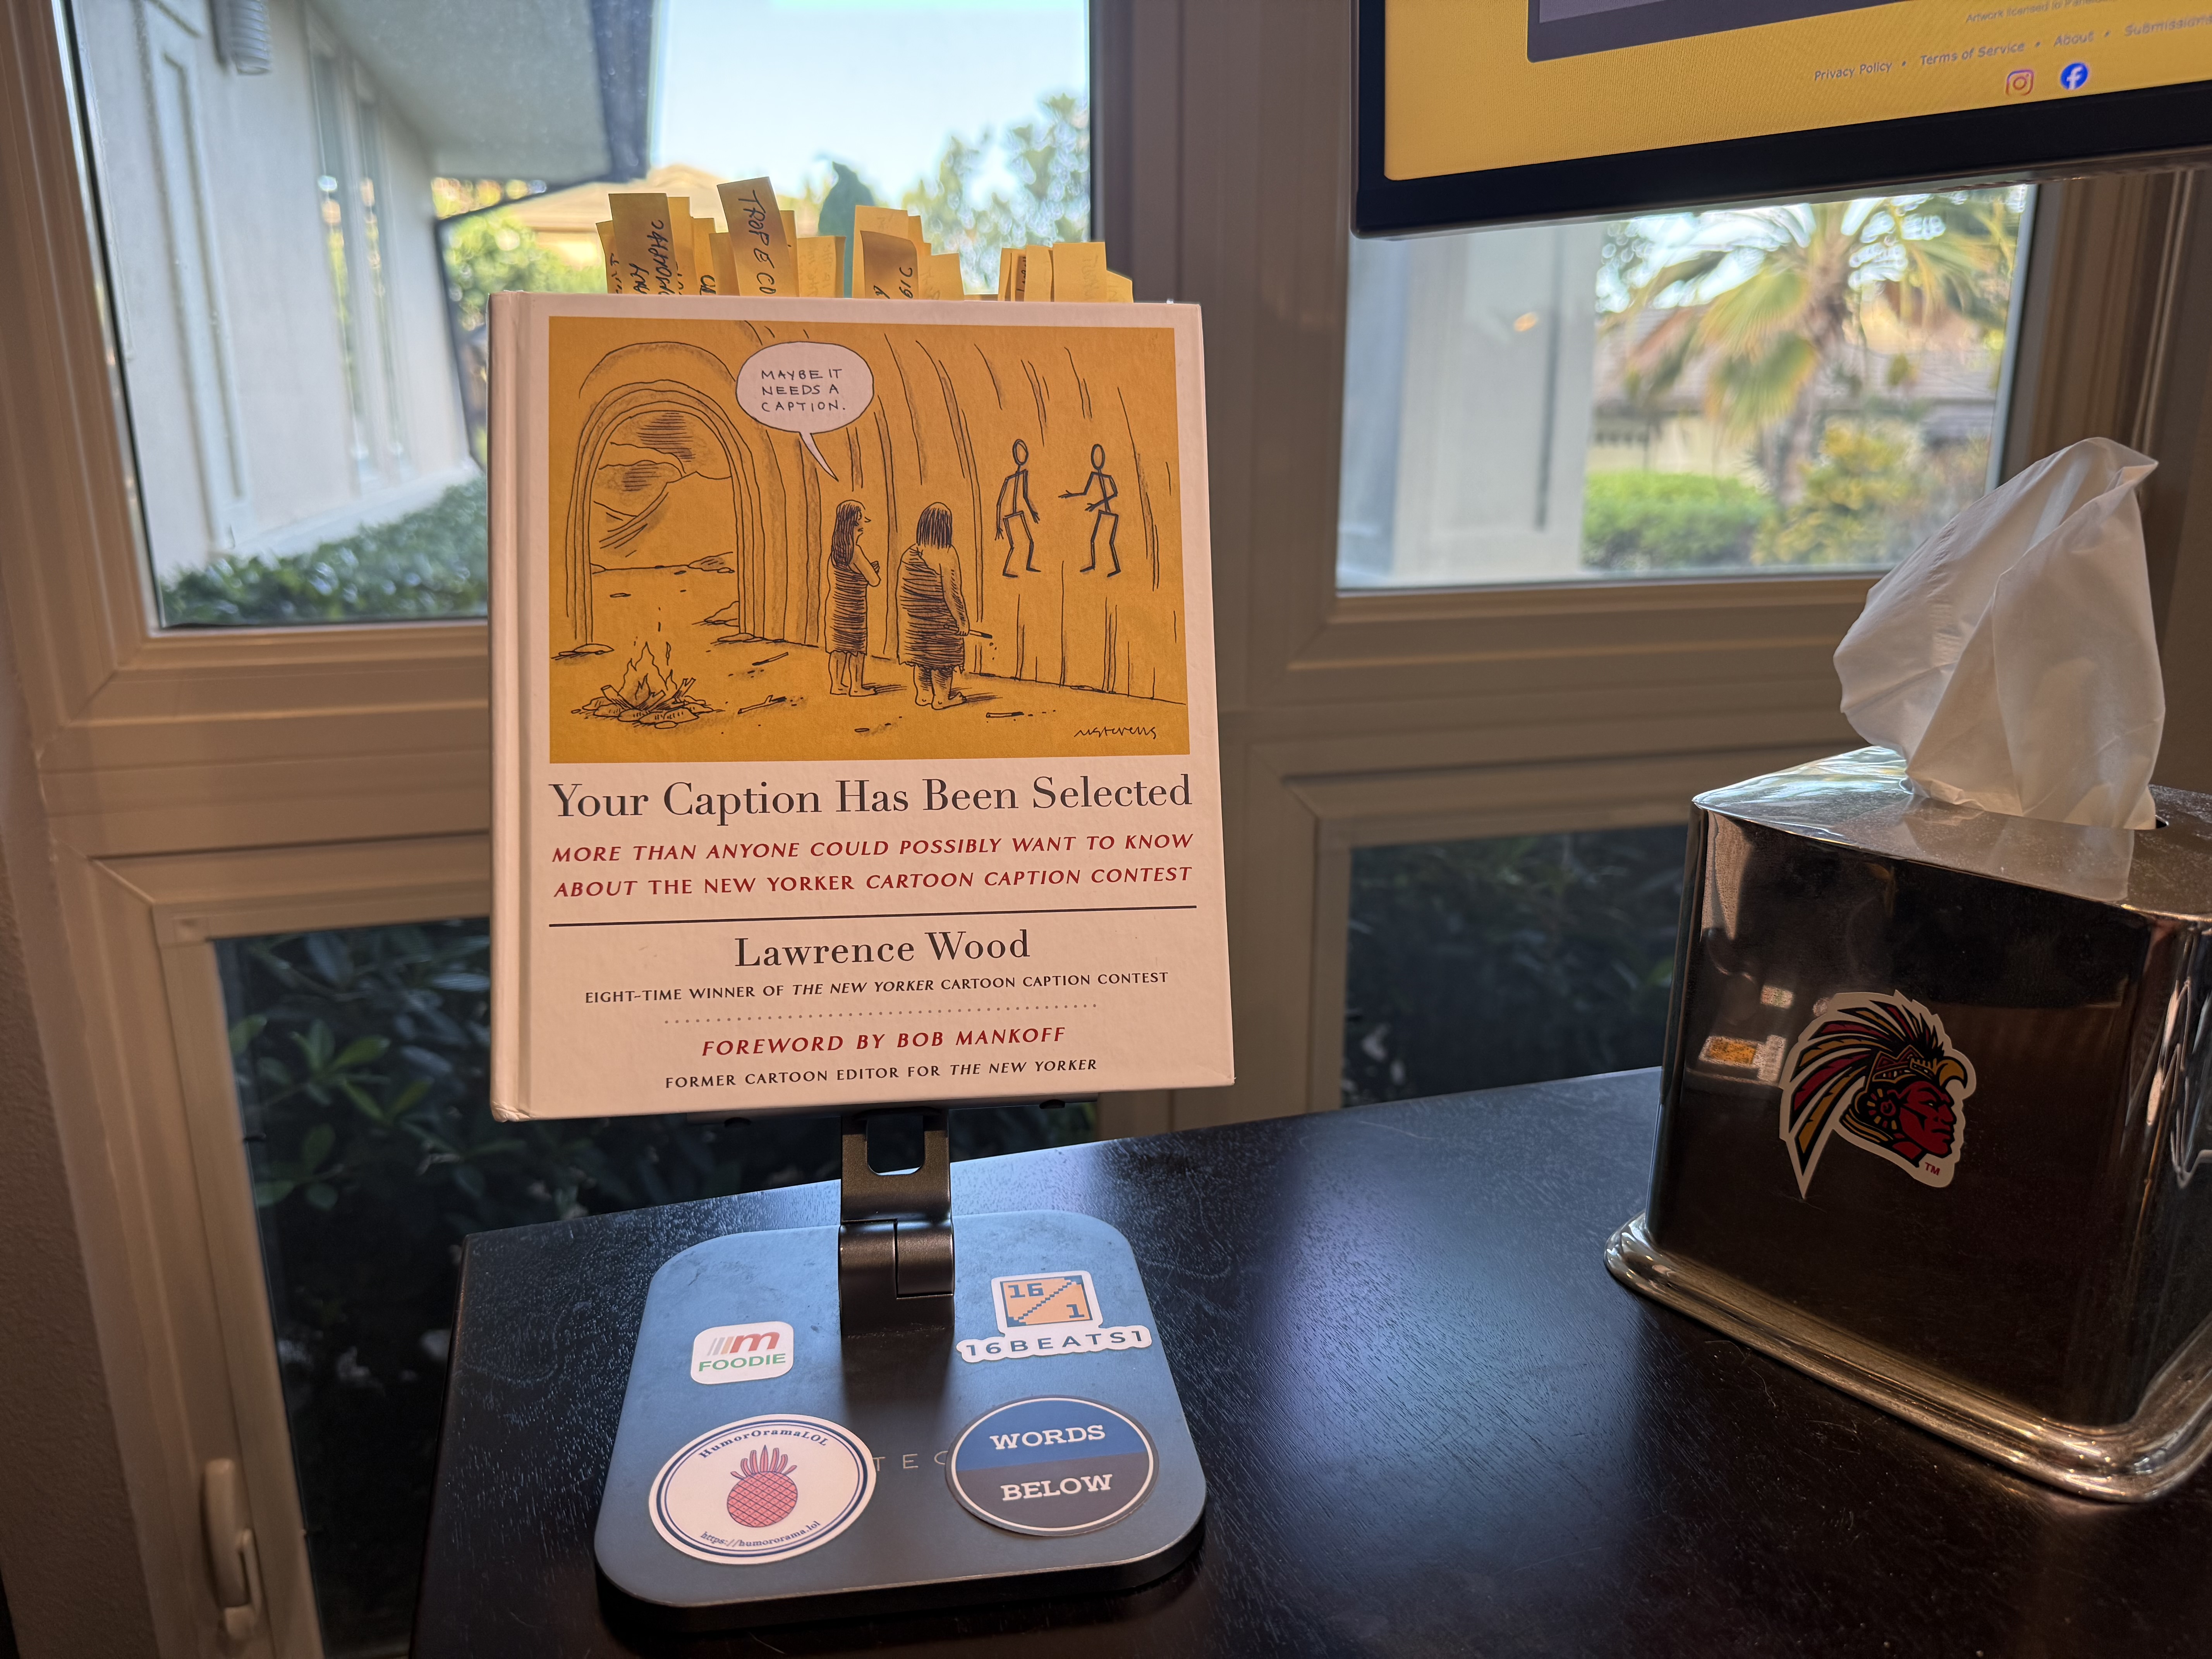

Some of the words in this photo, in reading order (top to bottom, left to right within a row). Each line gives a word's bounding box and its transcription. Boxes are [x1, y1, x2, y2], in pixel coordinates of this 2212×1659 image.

[1815, 67, 1855, 81] Privacy
[1859, 61, 1892, 74] Policy
[1921, 55, 1958, 65] Terms
[1961, 48, 1974, 60] of
[1978, 42, 2025, 58] Service
[2054, 31, 2094, 46] About
[762, 370, 823, 380] MAYBE
[829, 369, 842, 378] IT
[762, 385, 820, 395] NEEDS
[830, 384, 838, 394] A
[762, 400, 845, 412] CAPTION.
[548, 784, 648, 816] Your
[664, 782, 822, 826] Caption
[836, 780, 908, 812] Has
[922, 779, 1018, 810] Been
[1034, 774, 1192, 808] Selected
[552, 847, 621, 862] MORE
[634, 845, 696, 860] THAN
[706, 843, 799, 859] ANYONE
[811, 842, 888, 856] COULD
[900, 838, 1001, 854] POSSIBLY
[1012, 837, 1076, 852] WANT
[1087, 836, 1114, 850] TO
[1125, 834, 1193, 849] KNOW
[554, 881, 637, 897] ABOUT
[648, 880, 692, 894] THE
[705, 878, 756, 893] NEW
[767, 876, 854, 891] YORKER
[867, 872, 973, 888] CARTOON
[985, 870, 1080, 886] CAPTION
[1092, 867, 1192, 883] CONTEST
[735, 938, 914, 966] Lawrence
[924, 929, 1030, 960] Wood
[586, 989, 681, 1003] EIGHT-TIME
[689, 987, 755, 998] WINNER
[763, 986, 783, 996] OF
[793, 984, 823, 995] THE
[830, 982, 867, 993] NEW
[875, 981, 934, 992] YORKER
[941, 977, 1014, 989] CARTOON
[1023, 975, 1089, 986] CAPTION
[1098, 972, 1168, 984] CONTEST
[702, 1036, 843, 1056] FOREWORD
[857, 1034, 885, 1049] BY
[897, 1032, 943, 1047] BOB
[956, 1027, 1065, 1045] MANKOFF
[666, 1075, 736, 1088] FORMER
[745, 1071, 826, 1084] CARTOON
[837, 1068, 899, 1080] EDITOR
[908, 1066, 940, 1077] FOR
[950, 1064, 981, 1075] THE
[989, 1062, 1027, 1073] NEW
[1035, 1060, 1096, 1071] YORKER
[1925, 1162, 1940, 1175] TM
[1008, 1283, 1044, 1298] 16
[1066, 1304, 1084, 1318] 1
[967, 1330, 1143, 1356] 16BEATS1
[699, 1353, 785, 1371] FOODIE
[699, 1430, 829, 1458] HumorOramaLOL
[990, 1425, 1105, 1449] WORDS
[1001, 1474, 1112, 1501] BELOW
[700, 1521, 821, 1547] https://humororama.lol
